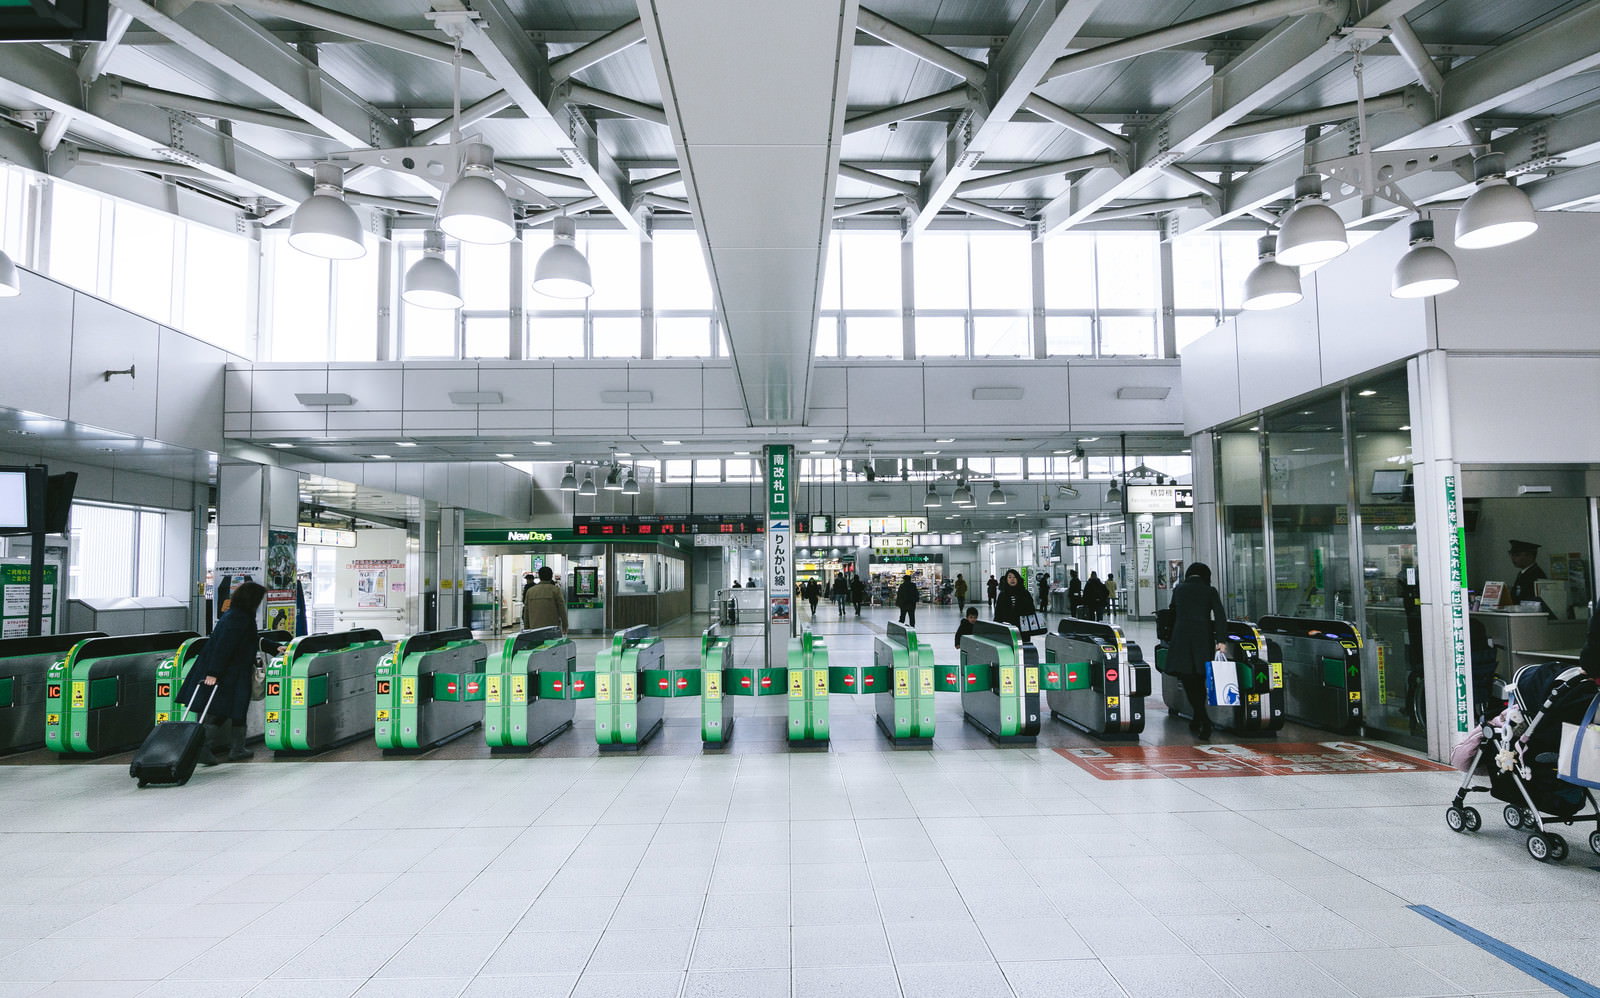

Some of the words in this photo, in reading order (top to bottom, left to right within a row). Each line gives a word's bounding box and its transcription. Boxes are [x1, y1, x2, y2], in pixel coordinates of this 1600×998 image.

[773, 454, 785, 504] 南改札口
[508, 531, 552, 541] NewDays
[774, 534, 786, 586] りんかい線
[50, 661, 64, 670] IC
[159, 660, 174, 669] IC
[268, 657, 283, 668] IC
[377, 656, 392, 667] IC
[49, 686, 60, 697] IC
[158, 685, 170, 696] IC
[268, 684, 280, 695] IC
[378, 682, 390, 693] IC
